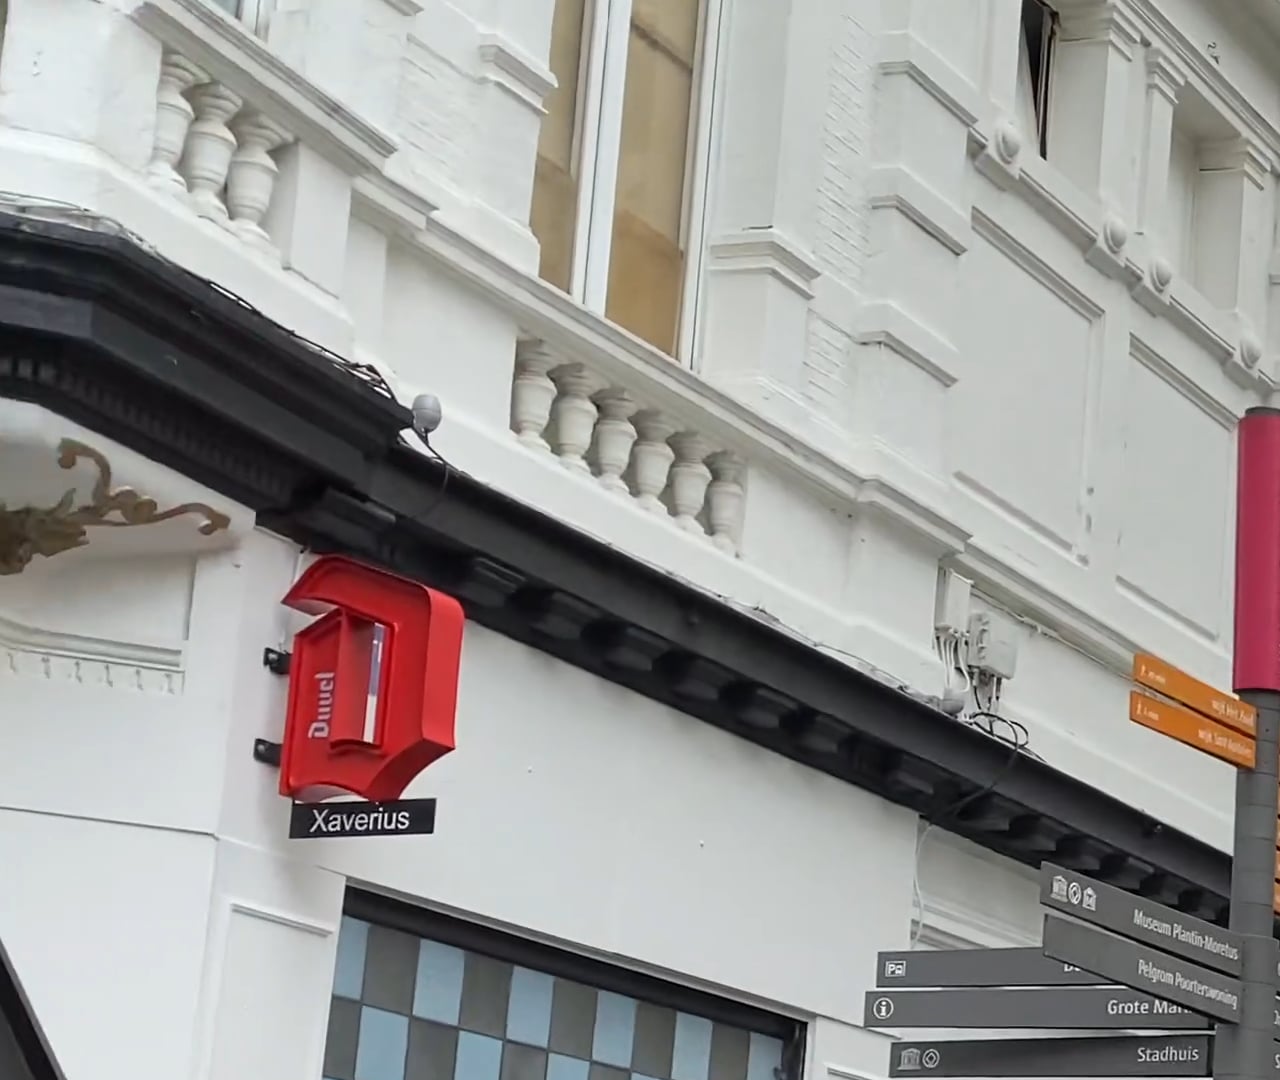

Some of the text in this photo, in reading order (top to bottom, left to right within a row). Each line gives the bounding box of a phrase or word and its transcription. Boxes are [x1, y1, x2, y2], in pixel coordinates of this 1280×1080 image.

[308, 672, 335, 739] Duvel
[309, 807, 411, 833] Xaverius
[1133, 909, 1239, 960] Museum Plantin-Moretus
[1138, 960, 1238, 1010] Pelgrom Poorterswoning
[1107, 1000, 1149, 1014] Grote
[1137, 1046, 1199, 1062] Stadhuis
